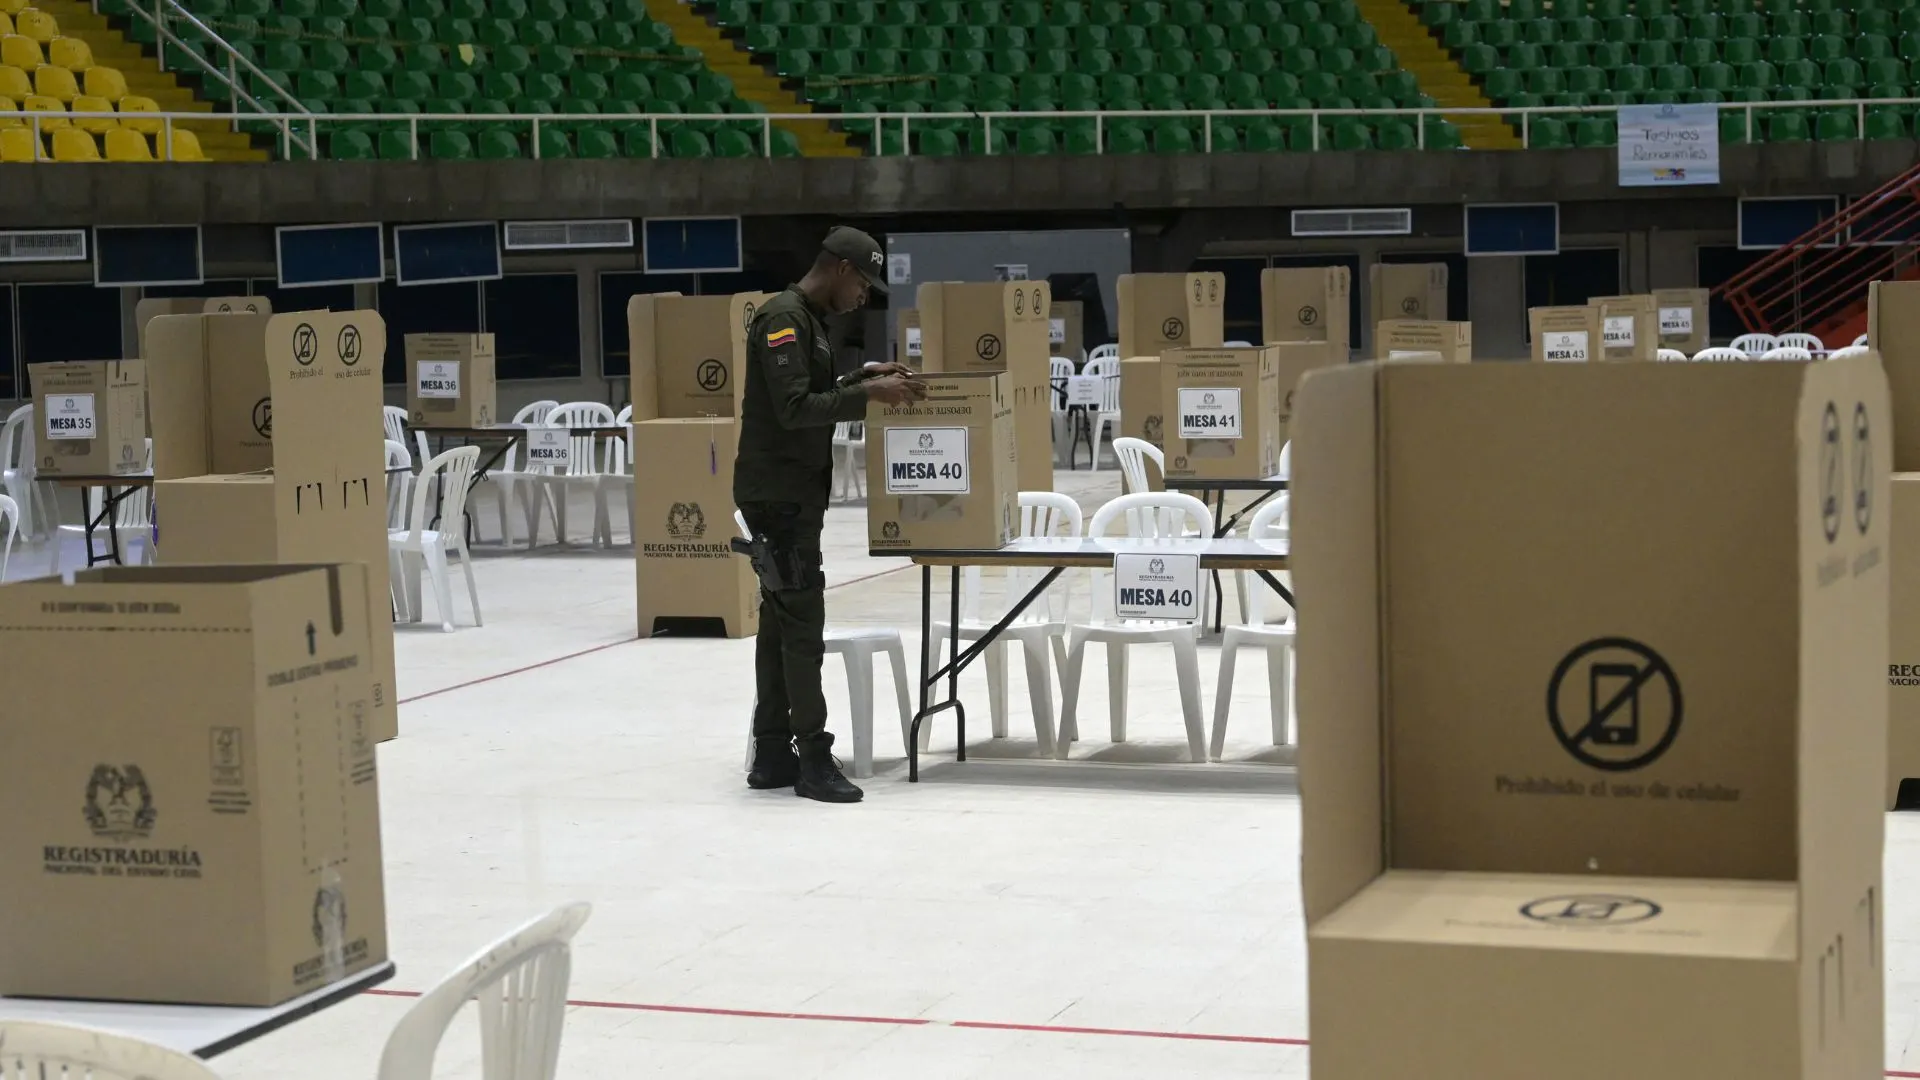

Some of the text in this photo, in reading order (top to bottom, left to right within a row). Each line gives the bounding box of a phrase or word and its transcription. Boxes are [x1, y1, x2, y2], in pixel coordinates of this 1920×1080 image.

[1621, 332, 1631, 340] 44
[1547, 351, 1585, 359] MESA 43
[420, 380, 456, 390] MESA 36
[936, 407, 972, 415] DEPOSITE
[50, 418, 91, 430] MESA 35
[1184, 415, 1235, 427] MESA 41
[530, 448, 567, 458] MESA 36
[892, 463, 962, 479] MESA 40
[643, 541, 730, 552] REGISTRADURÍA
[1120, 588, 1192, 607] MESA 40
[44, 844, 202, 866] REGISTRADURÍA
